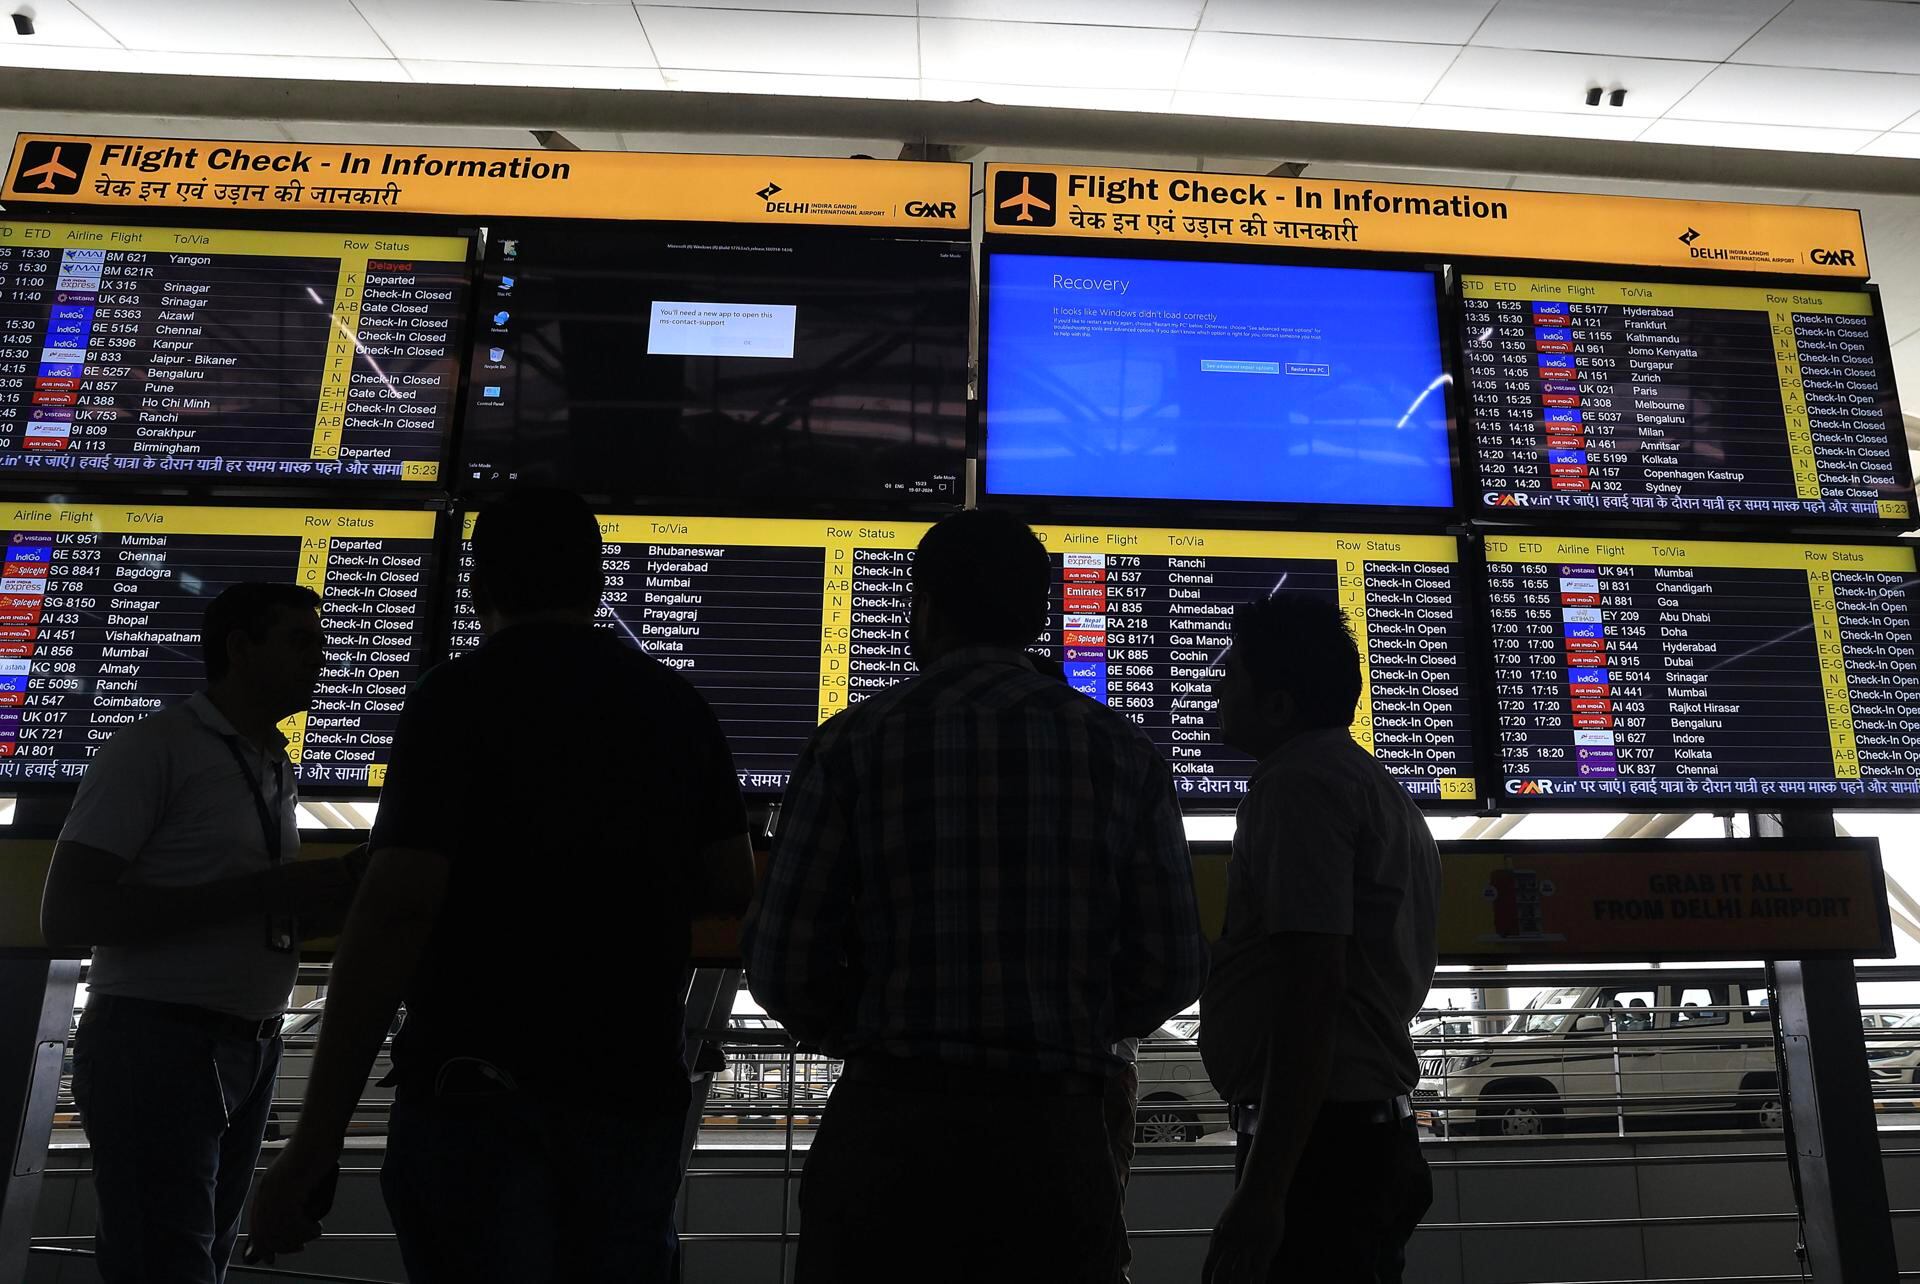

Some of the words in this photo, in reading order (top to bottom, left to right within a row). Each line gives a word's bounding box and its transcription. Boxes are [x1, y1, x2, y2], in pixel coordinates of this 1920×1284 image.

[100, 144, 199, 172] Flight
[208, 148, 312, 172] Check
[340, 152, 370, 174] In
[381, 153, 570, 179] Information
[94, 173, 134, 197] चेक
[138, 181, 171, 202] इन
[176, 177, 208, 202] एवं
[214, 184, 270, 205] उड़ान
[274, 179, 304, 202] की
[311, 182, 402, 205] जानकारी
[1069, 175, 1158, 204] Flight
[1169, 179, 1267, 206] Check
[1296, 186, 1322, 209] In
[1334, 188, 1507, 219] Information
[766, 202, 809, 213] DELHI
[858, 209, 885, 217] AIRPORT
[905, 201, 956, 219] GMR
[1069, 204, 1107, 229] चेक
[1112, 213, 1141, 234] इन
[1146, 209, 1176, 235] एवं
[1182, 216, 1234, 239] उड़ान
[1239, 213, 1268, 237] की
[1273, 218, 1358, 242] जानकारी
[24, 228, 51, 239] ETD
[67, 230, 103, 241] Airline
[111, 232, 142, 244] Flight
[173, 234, 209, 244] To/Via
[344, 240, 369, 249] Row
[374, 241, 409, 251] Status
[21, 249, 50, 258] 15:30
[106, 252, 124, 261] 8M
[127, 253, 146, 262] 621
[1690, 247, 1728, 260] DELHI
[1810, 249, 1856, 266] GMR
[170, 254, 211, 266] Yangon
[369, 262, 411, 270] Delayed
[16, 277, 44, 286] 11:00
[101, 280, 113, 289] IX
[116, 281, 137, 290] 315
[1053, 274, 1129, 295] Recovery
[164, 282, 211, 294] Srinagar
[363, 289, 410, 301] Check-In
[411, 289, 452, 301] Closed
[1464, 300, 1489, 309] 13:30
[1496, 301, 1521, 310] 15:25
[1569, 304, 1583, 313] 6E
[1585, 305, 1608, 314] 5177
[1061, 307, 1082, 316] looks
[1084, 308, 1098, 316] like
[1099, 308, 1137, 318] Windows
[1139, 310, 1161, 319] didn't
[1164, 310, 1181, 319] load
[1183, 313, 1217, 323] correctly
[1623, 307, 1674, 317] Hyderabad
[1776, 313, 1785, 322] N
[659, 319, 725, 327] ms-contact-support
[1792, 313, 1834, 325] Check-In
[1835, 315, 1867, 326] Closed
[141, 397, 157, 408] Ho
[159, 397, 179, 409] Chi
[182, 398, 211, 410] Minh
[68, 440, 81, 450] AI
[85, 441, 106, 450] 113
[133, 442, 200, 454] Birmingham
[313, 446, 337, 456] E-G
[340, 447, 391, 459] Departed
[406, 465, 437, 476] 15:23
[1644, 469, 1705, 481] Copenhagen
[1707, 470, 1744, 482] Kastrup
[1880, 503, 1907, 514] 15:23
[56, 534, 74, 544] UK
[77, 534, 98, 544] 951
[121, 535, 167, 546] Mumbai
[303, 538, 327, 549] A-B
[331, 539, 382, 551] Departed
[649, 546, 725, 557] Bhubaneswar
[835, 549, 844, 560] D
[1107, 556, 1117, 566] I5
[1120, 556, 1140, 566] 776
[1168, 558, 1205, 568] Ranchi
[1364, 562, 1411, 573] Check-In
[1414, 564, 1449, 574] Closed
[1067, 587, 1102, 596] Emirates
[1107, 587, 1123, 597] EK
[1126, 587, 1146, 597] 517
[1169, 588, 1200, 598] Dubai
[644, 608, 697, 622] Prayagraj
[1490, 609, 1517, 618] 16:55
[1525, 609, 1551, 619] 16:55
[1603, 611, 1617, 620] EY
[1620, 611, 1639, 621] 209
[1659, 612, 1679, 621] Abu
[1682, 612, 1711, 622] Dhabi
[1822, 615, 1829, 625] L
[1838, 616, 1881, 627] Check-In
[1882, 617, 1910, 630] Open
[105, 631, 201, 644] Vishakhapatnam
[641, 640, 683, 652] Kolkata
[93, 696, 161, 707] Coimbatore
[749, 774, 781, 787] समय
[1444, 782, 1474, 792] 15:23
[1649, 873, 1717, 893] GRAB
[1721, 873, 1746, 892] IT
[1751, 872, 1791, 891] ALL
[1593, 899, 1665, 920] FROM
[1672, 899, 1742, 919] DELHI
[1749, 897, 1851, 918] AIRPORT
